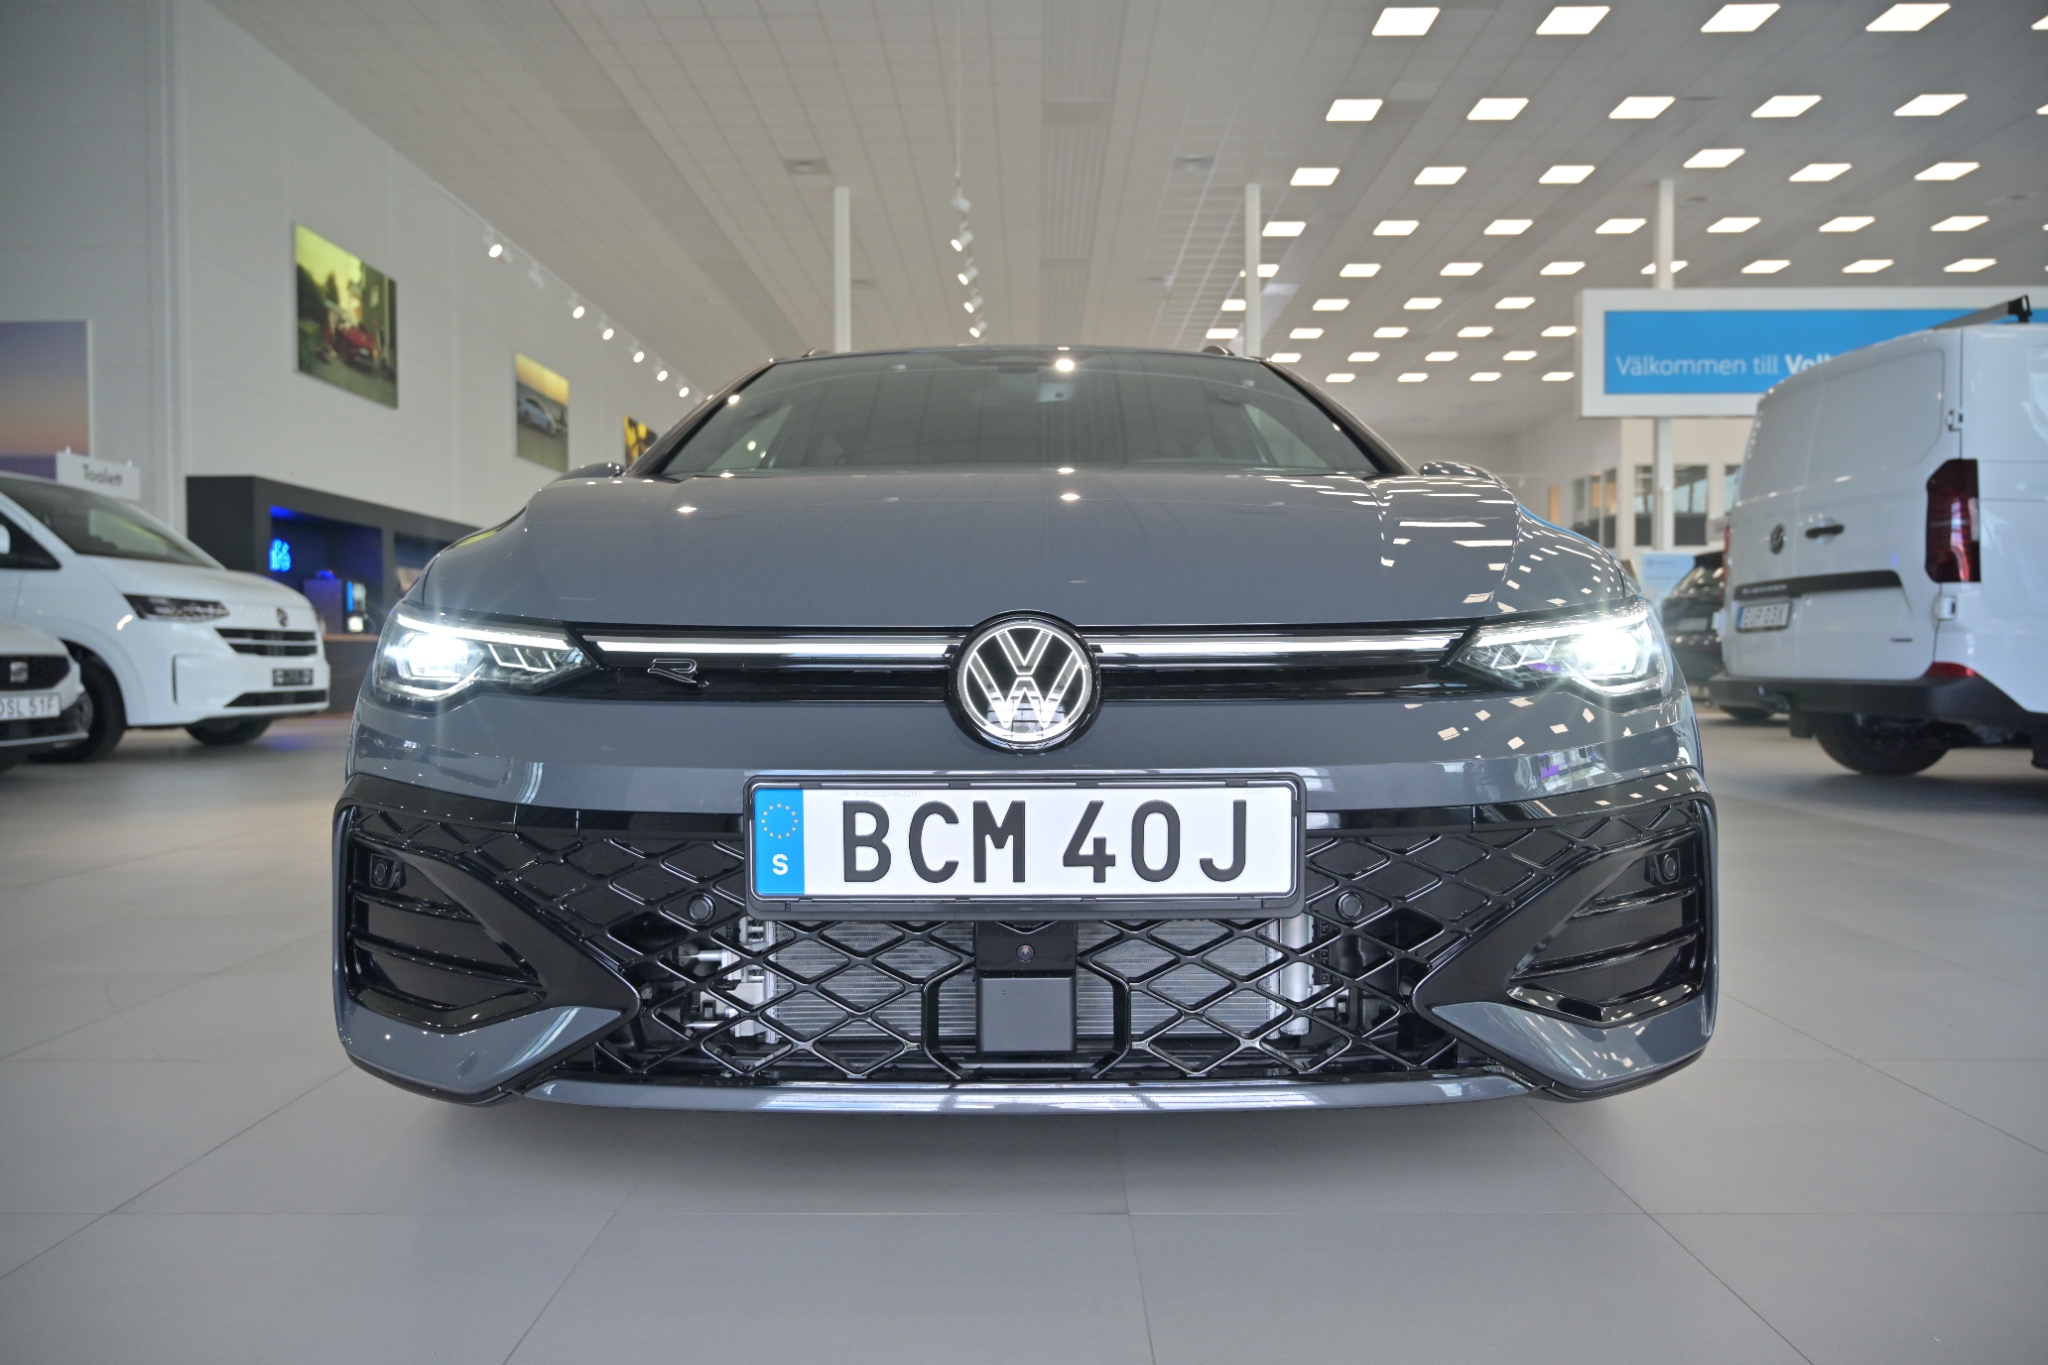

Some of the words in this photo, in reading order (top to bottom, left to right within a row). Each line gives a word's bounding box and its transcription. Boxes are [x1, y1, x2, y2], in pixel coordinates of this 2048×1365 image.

[1615, 353, 1747, 376] Välkommen
[1753, 353, 1779, 375] till
[843, 801, 1026, 883] BCM
[1063, 800, 1247, 883] 40J
[772, 853, 789, 876] S
